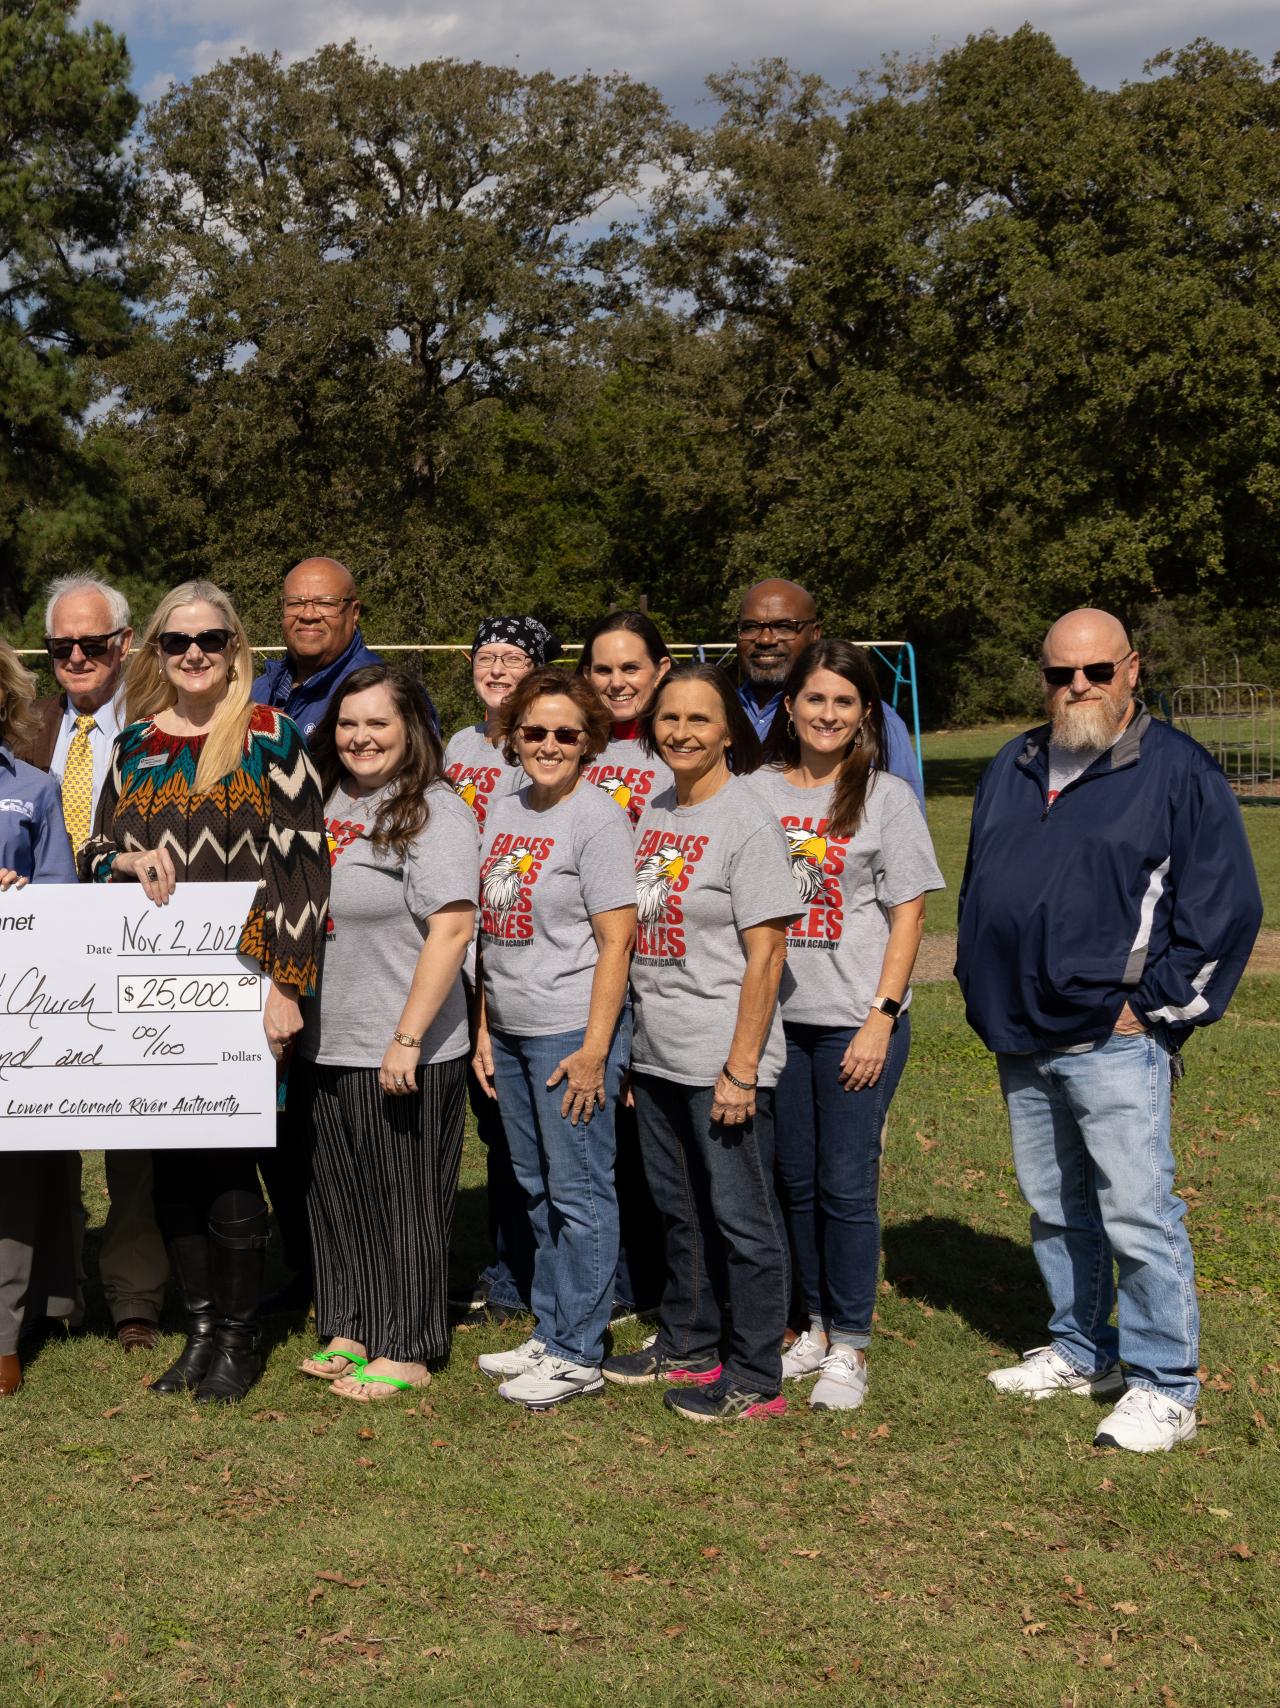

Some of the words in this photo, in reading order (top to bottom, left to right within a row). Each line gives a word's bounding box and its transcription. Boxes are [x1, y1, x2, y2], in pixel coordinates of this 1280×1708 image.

[122, 910, 162, 954] Nov.
[196, 922, 246, 952] 202
[86, 944, 113, 955] Date
[6, 966, 117, 1030] Church
[55, 1044, 104, 1067] and
[222, 1051, 262, 1063] Dollars
[6, 1099, 53, 1116] Lower
[58, 1098, 123, 1115] Colorado
[129, 1097, 168, 1116] River
[172, 1094, 241, 1117] Authority
